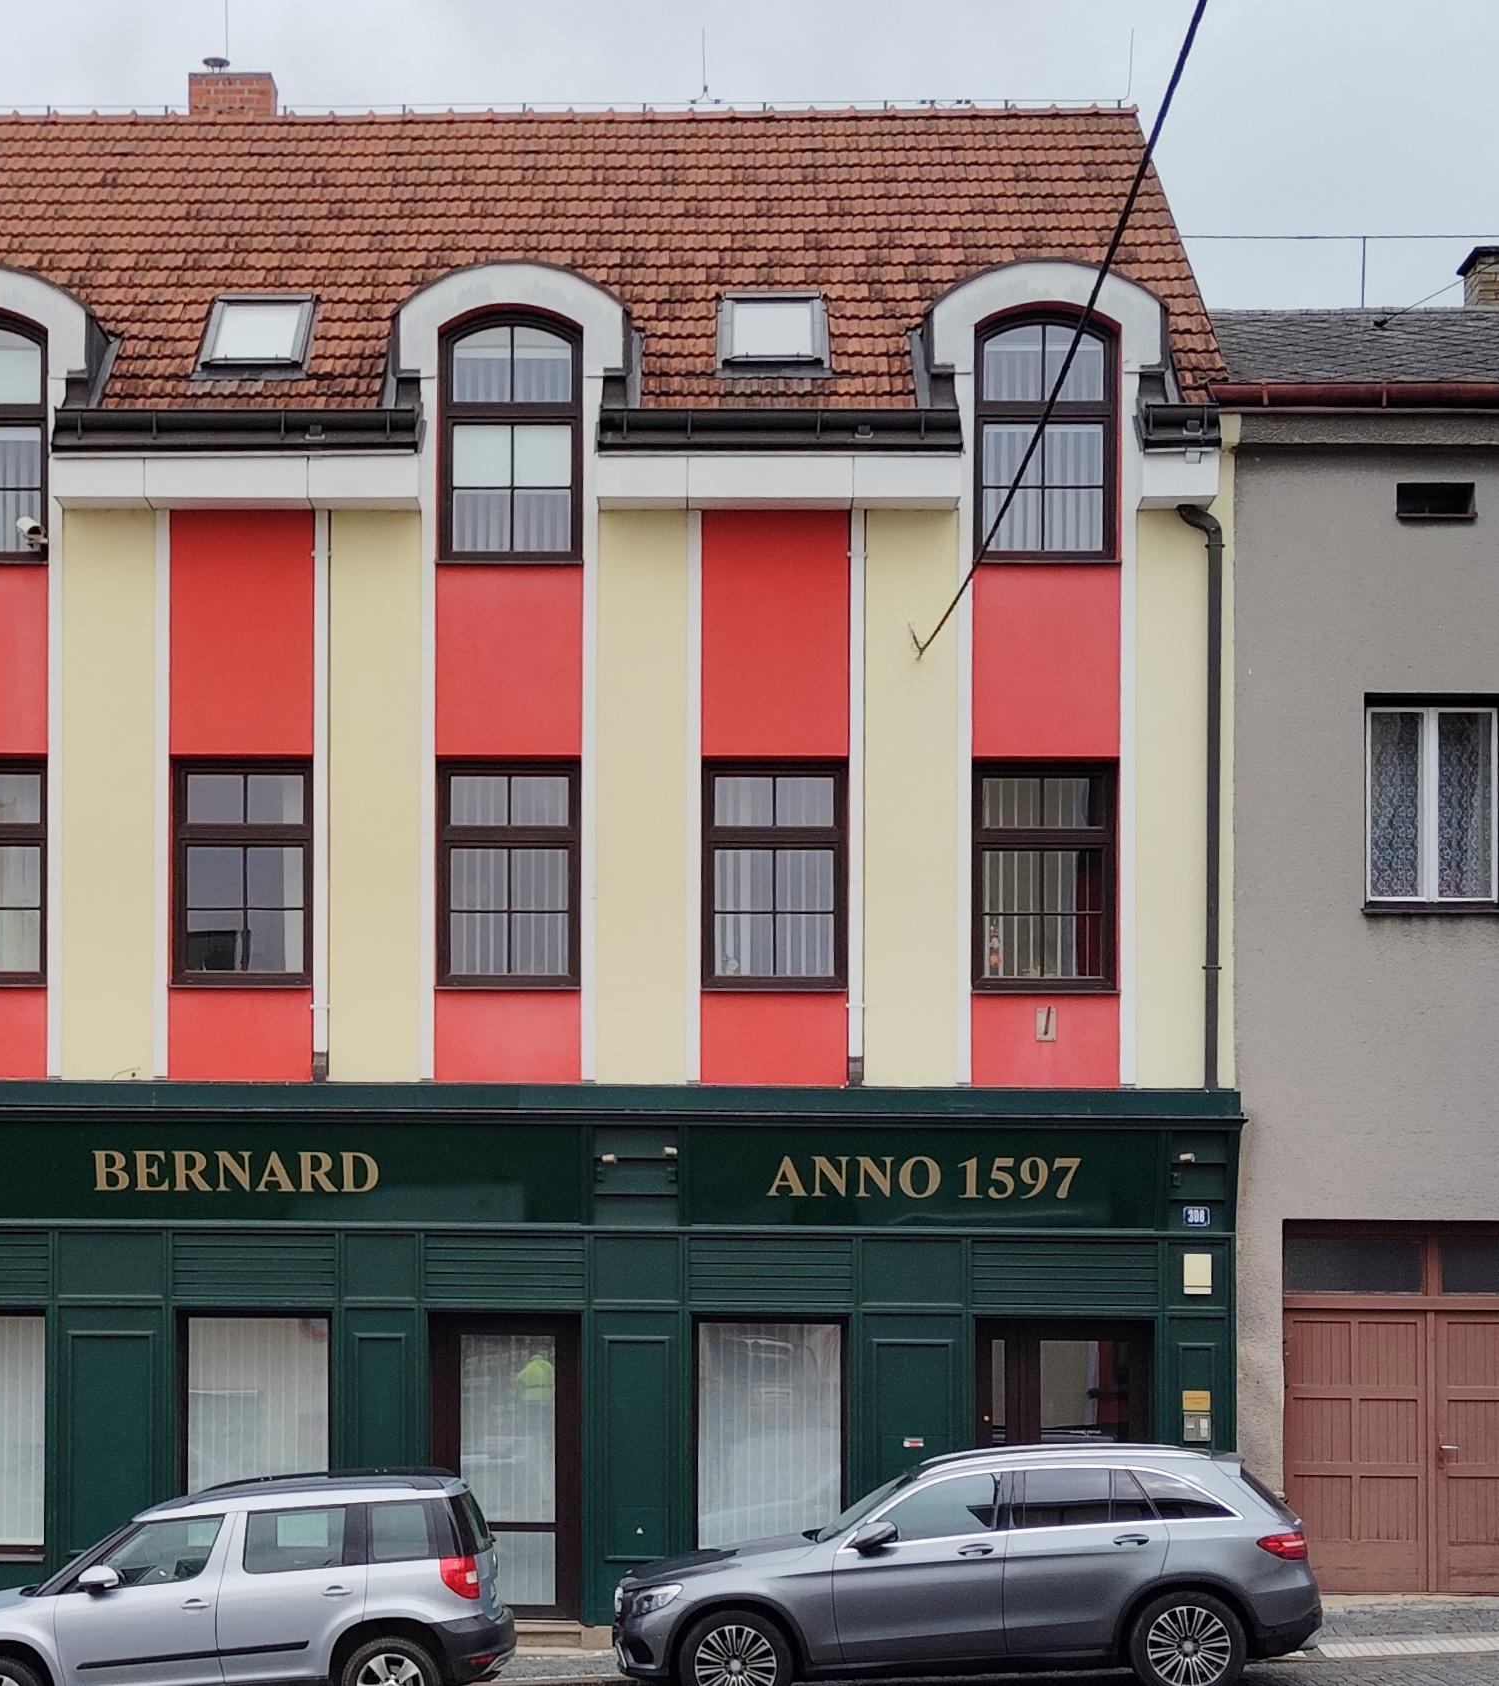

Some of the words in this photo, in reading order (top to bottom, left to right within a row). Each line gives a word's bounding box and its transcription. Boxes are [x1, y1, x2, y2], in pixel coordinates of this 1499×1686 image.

[91, 1149, 380, 1193] BERNARD
[765, 1155, 942, 1200] ANNO
[956, 1155, 1083, 1200] 1597
